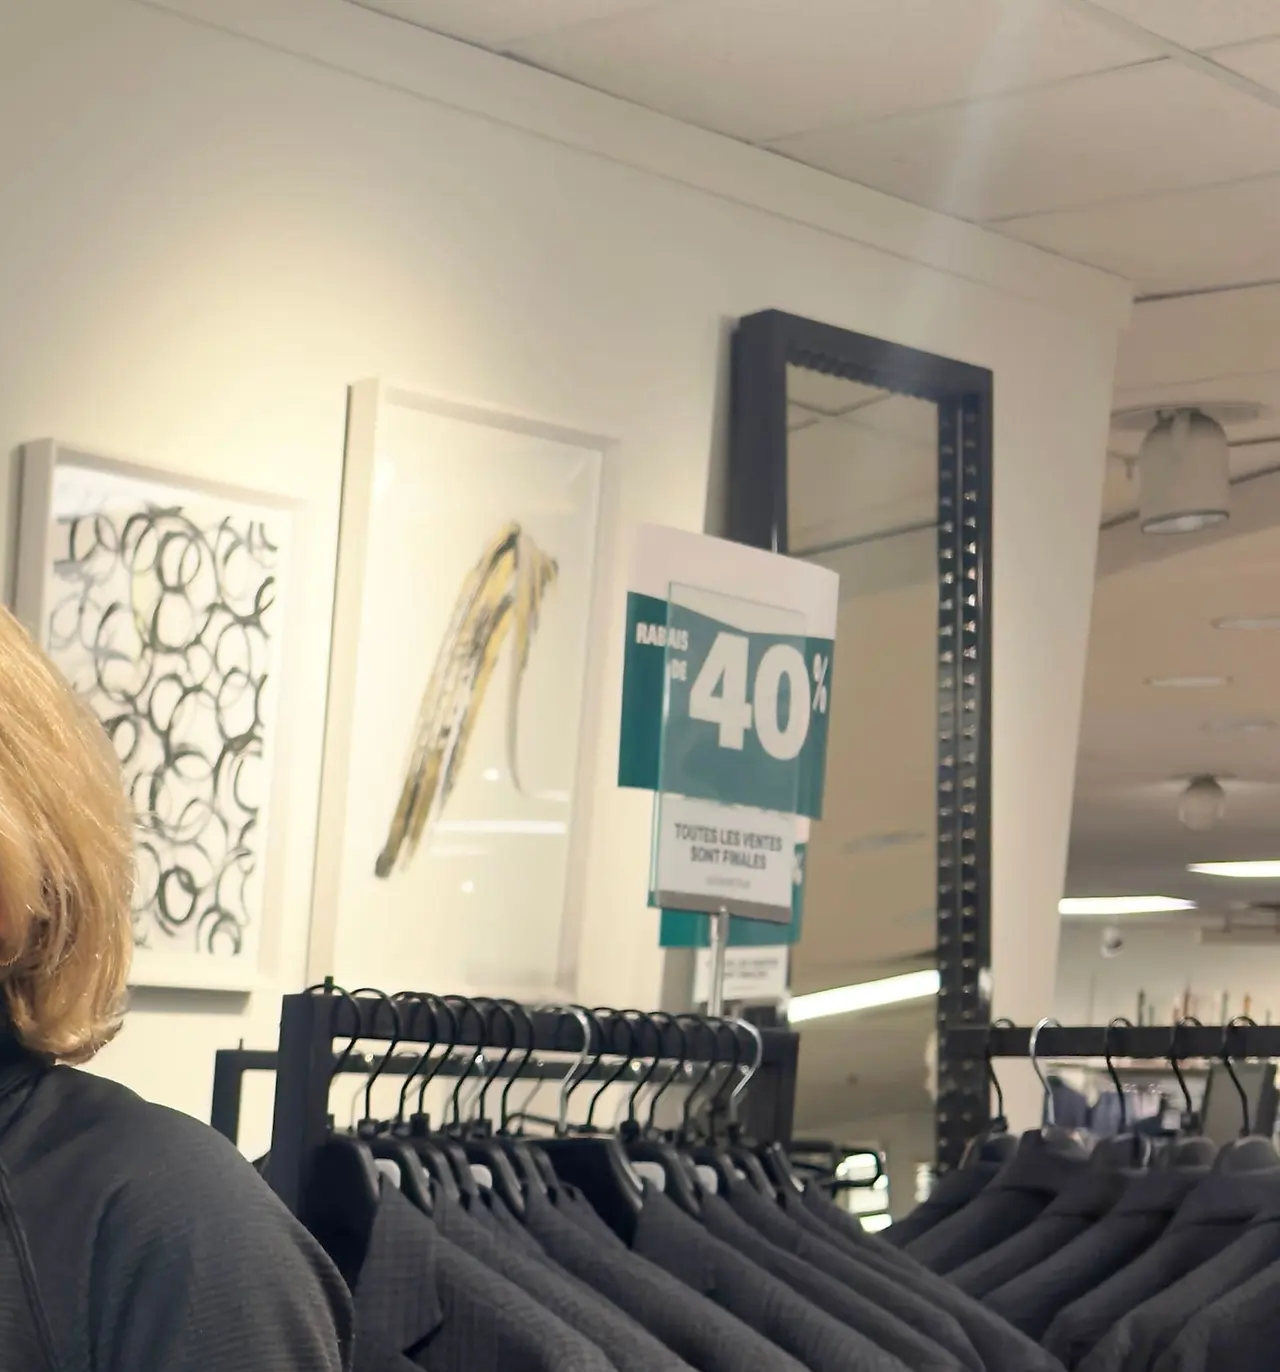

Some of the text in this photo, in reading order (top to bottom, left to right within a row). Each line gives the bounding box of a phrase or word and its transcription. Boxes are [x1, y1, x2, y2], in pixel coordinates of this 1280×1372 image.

[635, 622, 689, 651] RABAIS
[670, 659, 688, 682] DE
[674, 822, 783, 852] TOUTES LES VENTES
[690, 846, 768, 870] SONT FINALES
